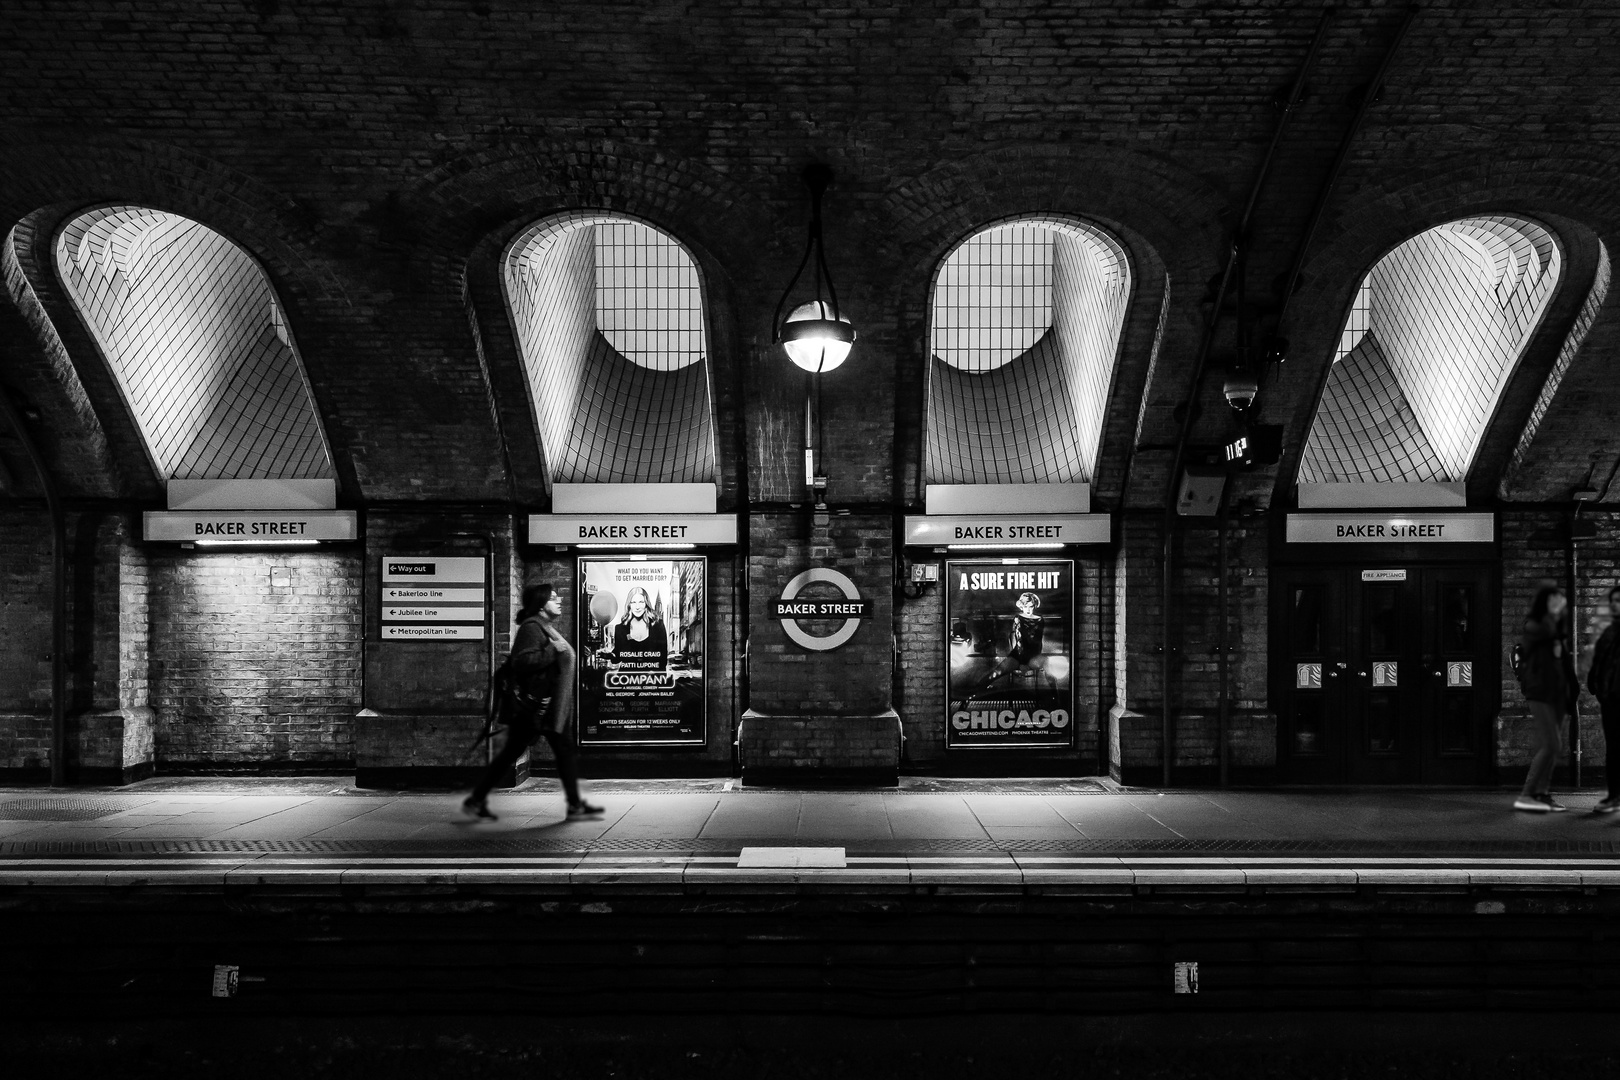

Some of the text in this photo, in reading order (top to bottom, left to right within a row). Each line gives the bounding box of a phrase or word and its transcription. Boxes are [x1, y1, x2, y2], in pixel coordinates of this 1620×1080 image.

[195, 522, 307, 534] BAKER STREET
[579, 526, 688, 538] BAKER STREET
[955, 526, 1062, 538] BAKER STREET
[1336, 525, 1445, 537] BAKER STREET
[960, 572, 1060, 590] A SURE FIRE HIT
[778, 604, 864, 614] BAKER STREET
[610, 675, 668, 685] COMPANY
[952, 709, 1069, 730] CHICAGO
